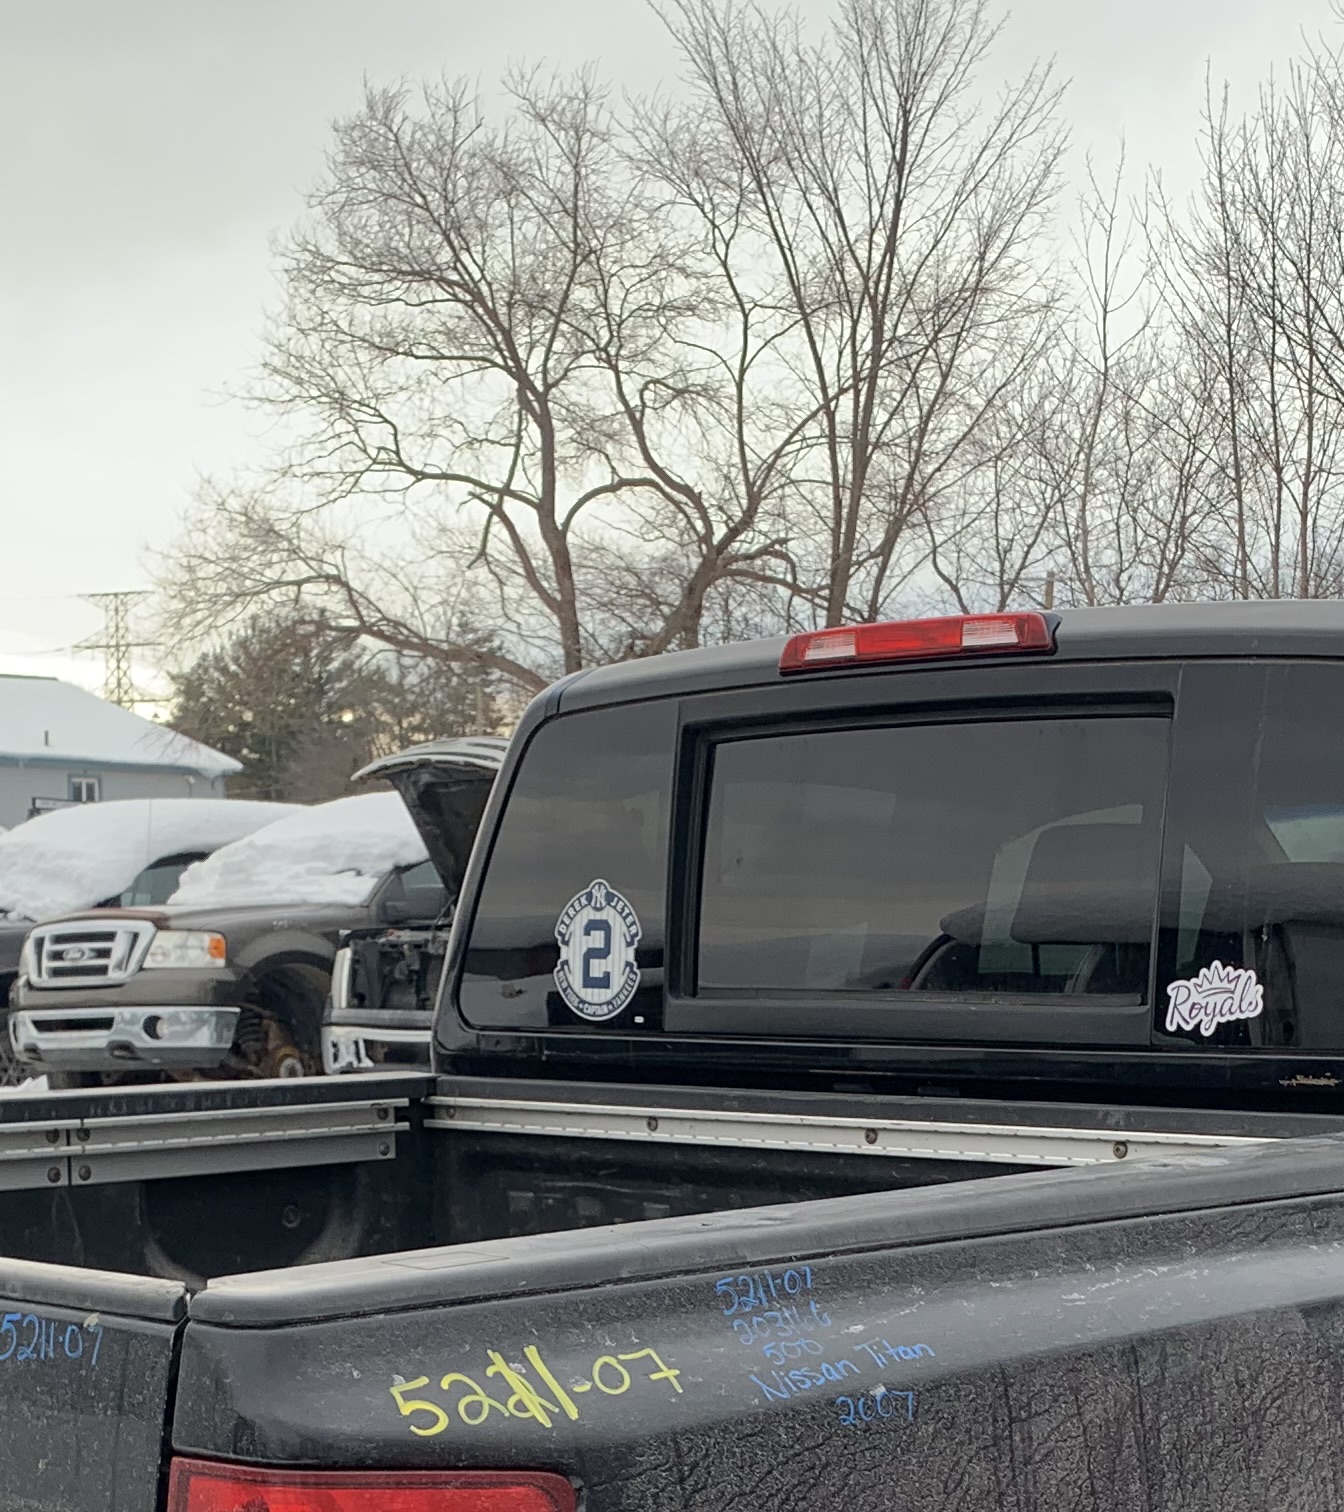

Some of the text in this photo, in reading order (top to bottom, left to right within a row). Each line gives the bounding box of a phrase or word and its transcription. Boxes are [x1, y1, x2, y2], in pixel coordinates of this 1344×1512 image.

[558, 894, 638, 936] DEREK JETER
[582, 918, 612, 989] 2
[1170, 974, 1259, 1032] Royals
[715, 1266, 813, 1317] 5211-07
[749, 1336, 936, 1401] Nissan Titan
[762, 1337, 824, 1366] 500
[835, 1390, 914, 1426] 2007
